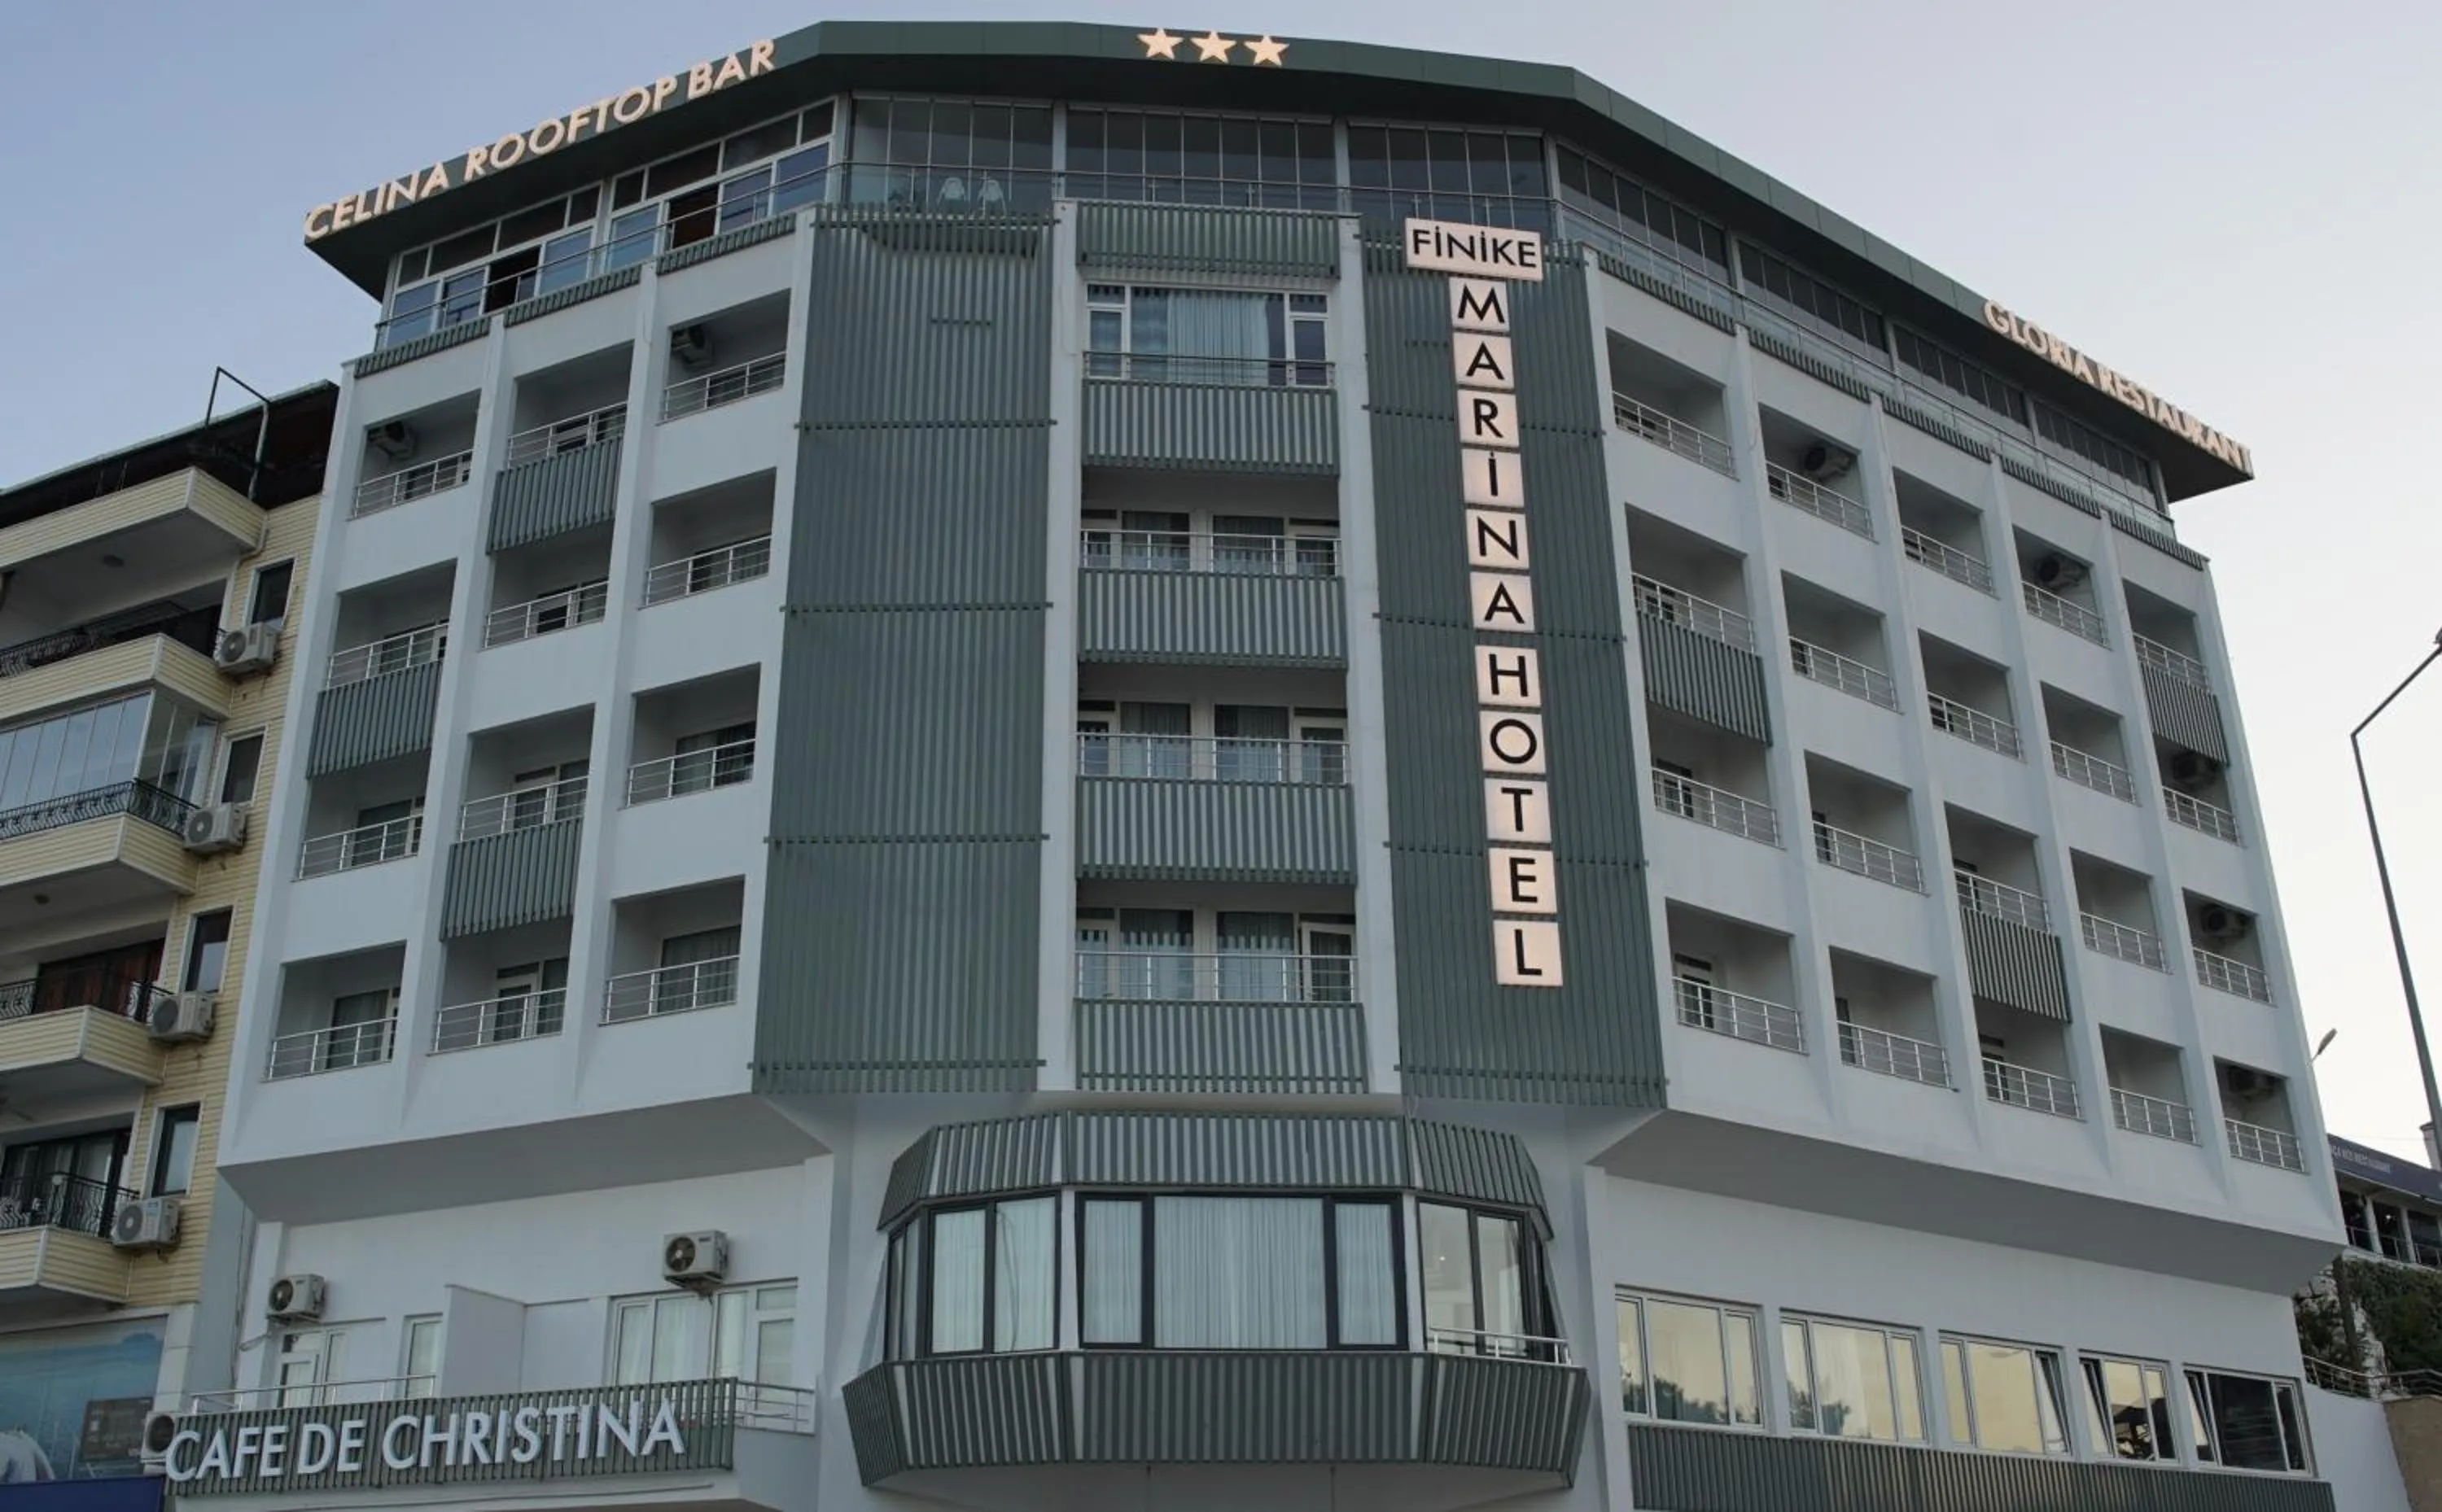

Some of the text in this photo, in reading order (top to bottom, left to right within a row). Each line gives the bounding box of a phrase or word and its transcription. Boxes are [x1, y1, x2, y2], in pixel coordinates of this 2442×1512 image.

[304, 38, 776, 239] CELINA ROOFTOP BAR
[1412, 225, 1537, 269] FİNİKE
[1984, 299, 2254, 477] GLORIA RESTAURANT
[1457, 285, 1543, 976] MARİNA HOTEL
[166, 1426, 288, 1481] CAFE
[297, 1419, 365, 1475] DE
[383, 1398, 685, 1467] CHRISTINA
